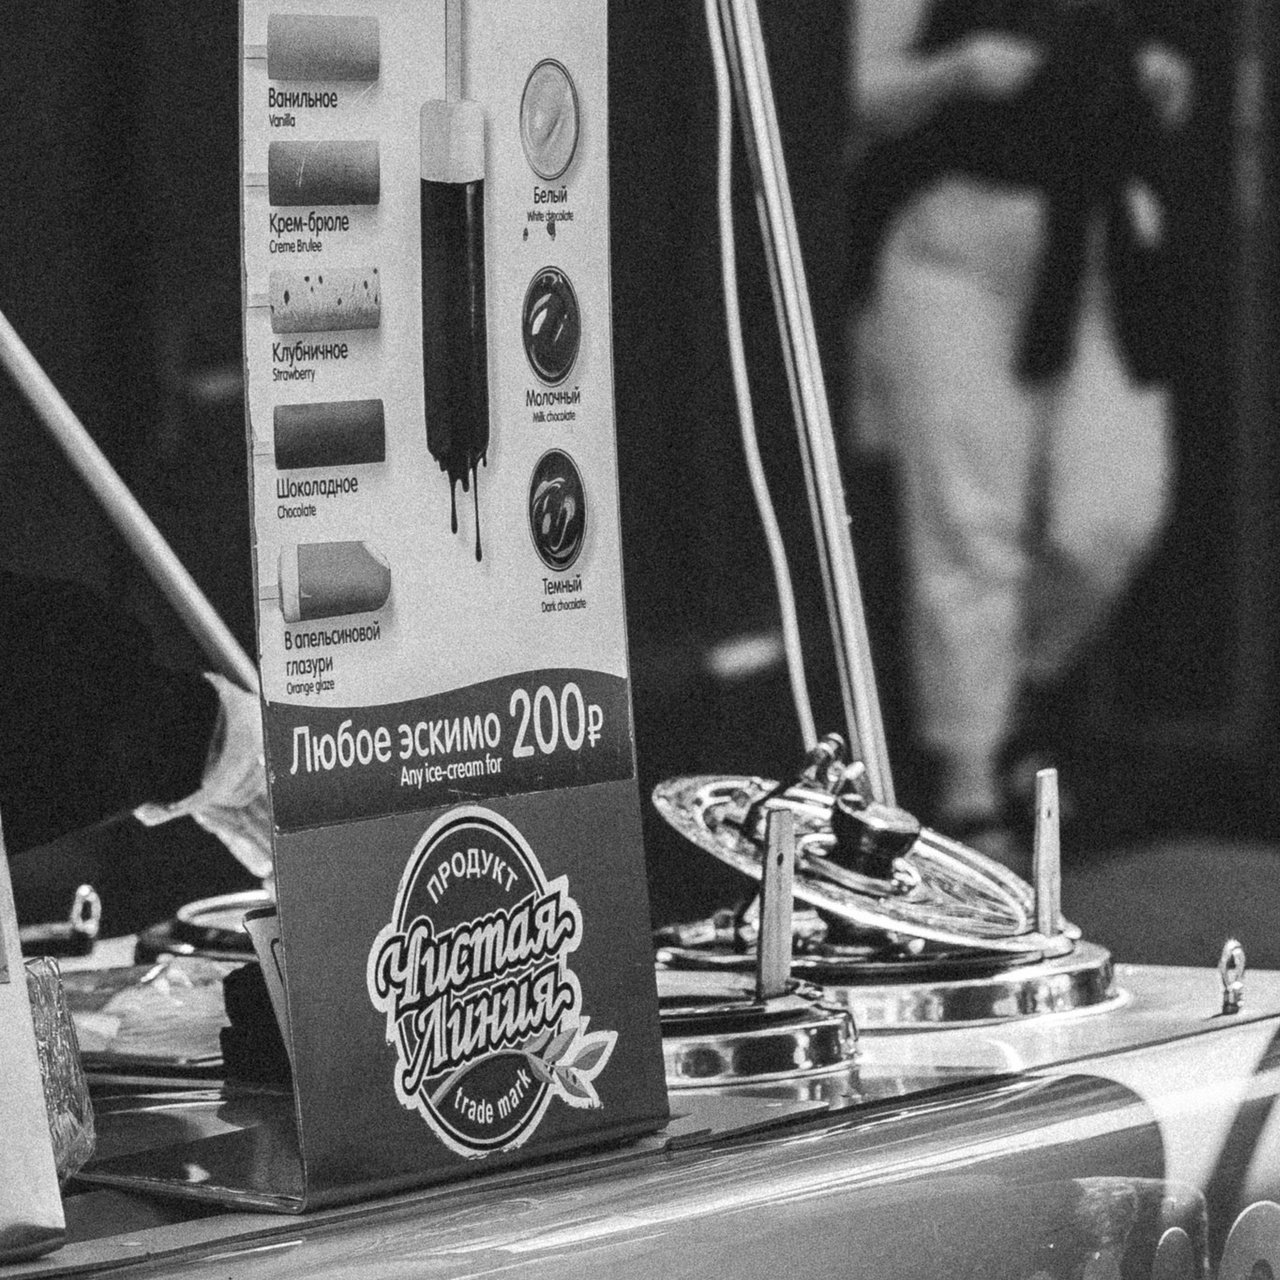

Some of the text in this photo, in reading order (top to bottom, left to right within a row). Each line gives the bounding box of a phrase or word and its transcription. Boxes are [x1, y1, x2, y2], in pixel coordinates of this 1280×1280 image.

[268, 87, 338, 108] Ванильное
[269, 113, 296, 127] Vanilla
[533, 185, 568, 204] Белый
[269, 211, 350, 239] Крем-брюле
[269, 238, 323, 253] Creme Brulee
[272, 341, 349, 368] Клубничное
[273, 366, 316, 383] Strawberry
[526, 386, 581, 407] Молочный
[276, 477, 359, 500] Шоколадное
[277, 503, 317, 520] Chocolate
[541, 574, 582, 595] Темный
[541, 601, 557, 613] Dark
[284, 621, 381, 651] В апельсиновой
[286, 656, 334, 678] глазури
[286, 680, 335, 696] Orange glaze
[289, 721, 392, 775] Любое
[398, 712, 501, 760] эскимо
[400, 754, 502, 787] Any ice-cream for
[426, 848, 519, 905] ПРОДУКТ
[376, 894, 574, 1004] Чистая
[404, 964, 573, 1092] Линия
[453, 1066, 533, 1125] trade mark
